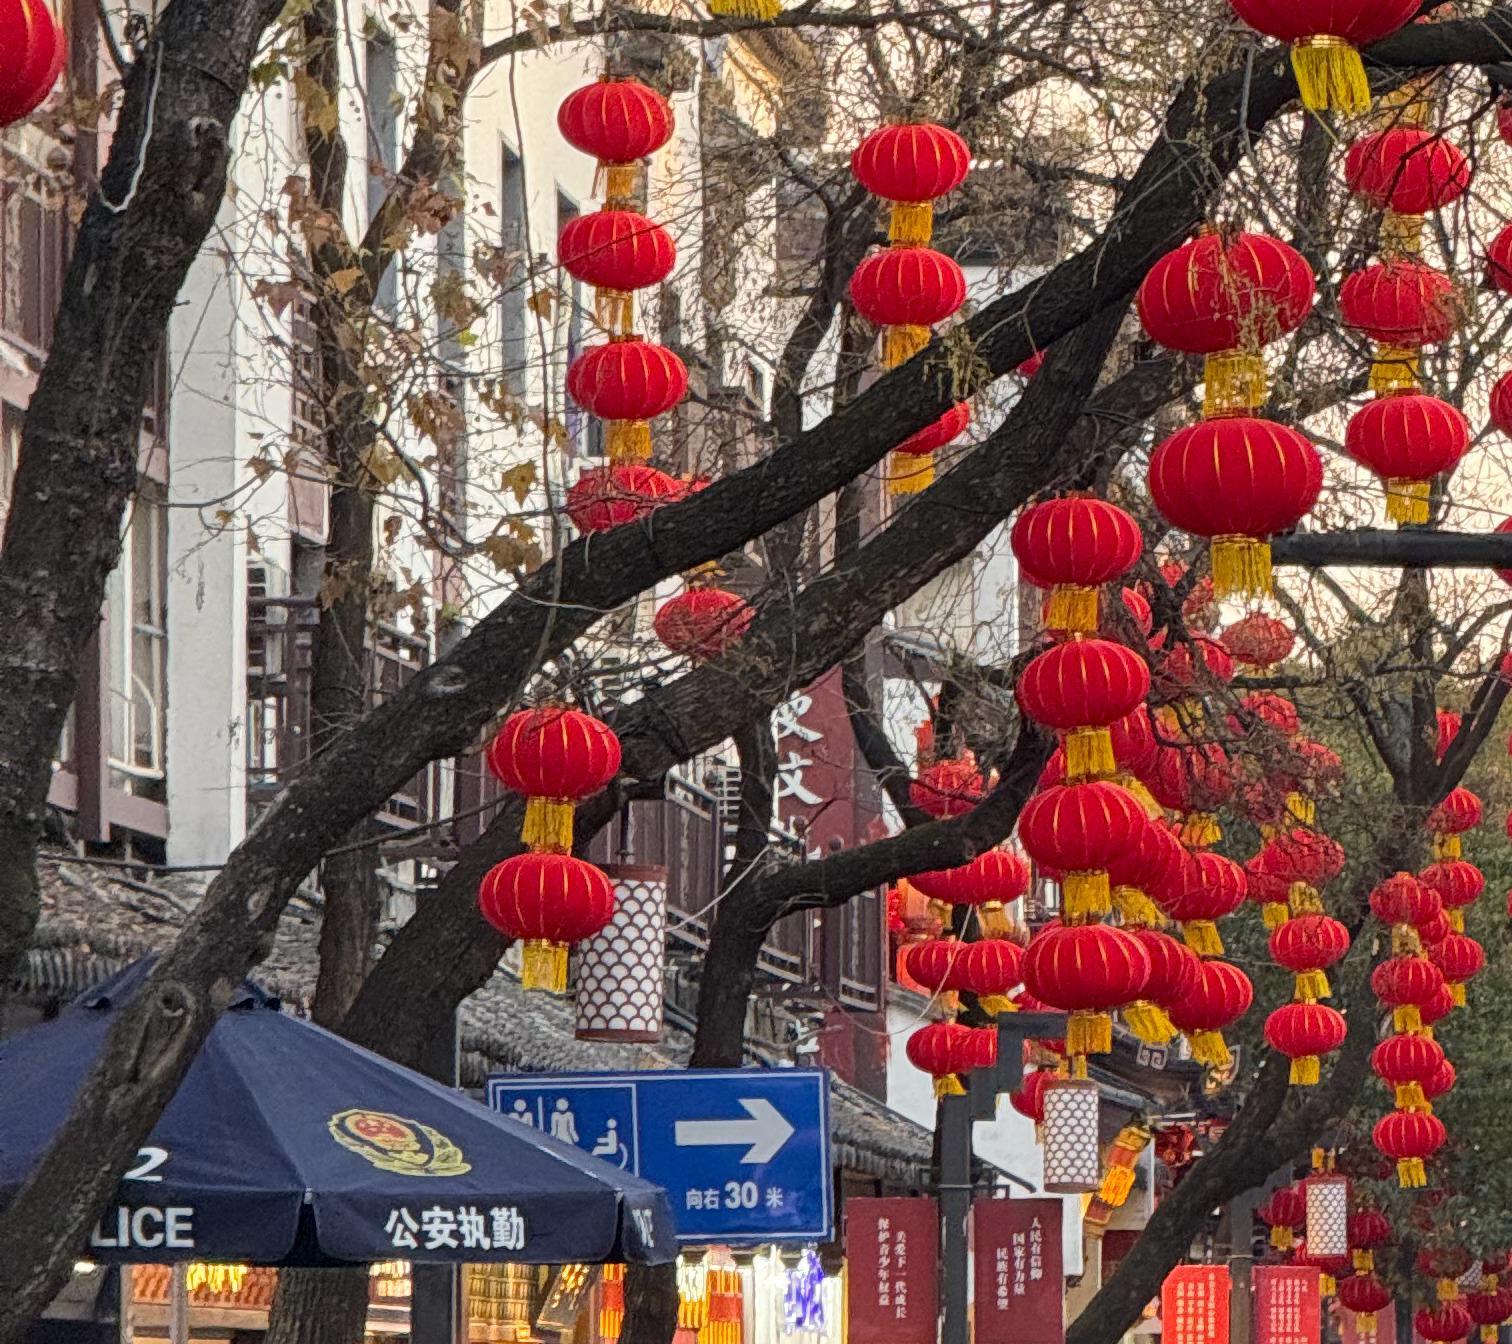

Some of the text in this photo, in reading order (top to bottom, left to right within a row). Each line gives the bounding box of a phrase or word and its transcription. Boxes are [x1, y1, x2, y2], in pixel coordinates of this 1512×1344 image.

[686, 1181, 783, 1211] 向右 30 米
[384, 1206, 526, 1250] 公安执勤
